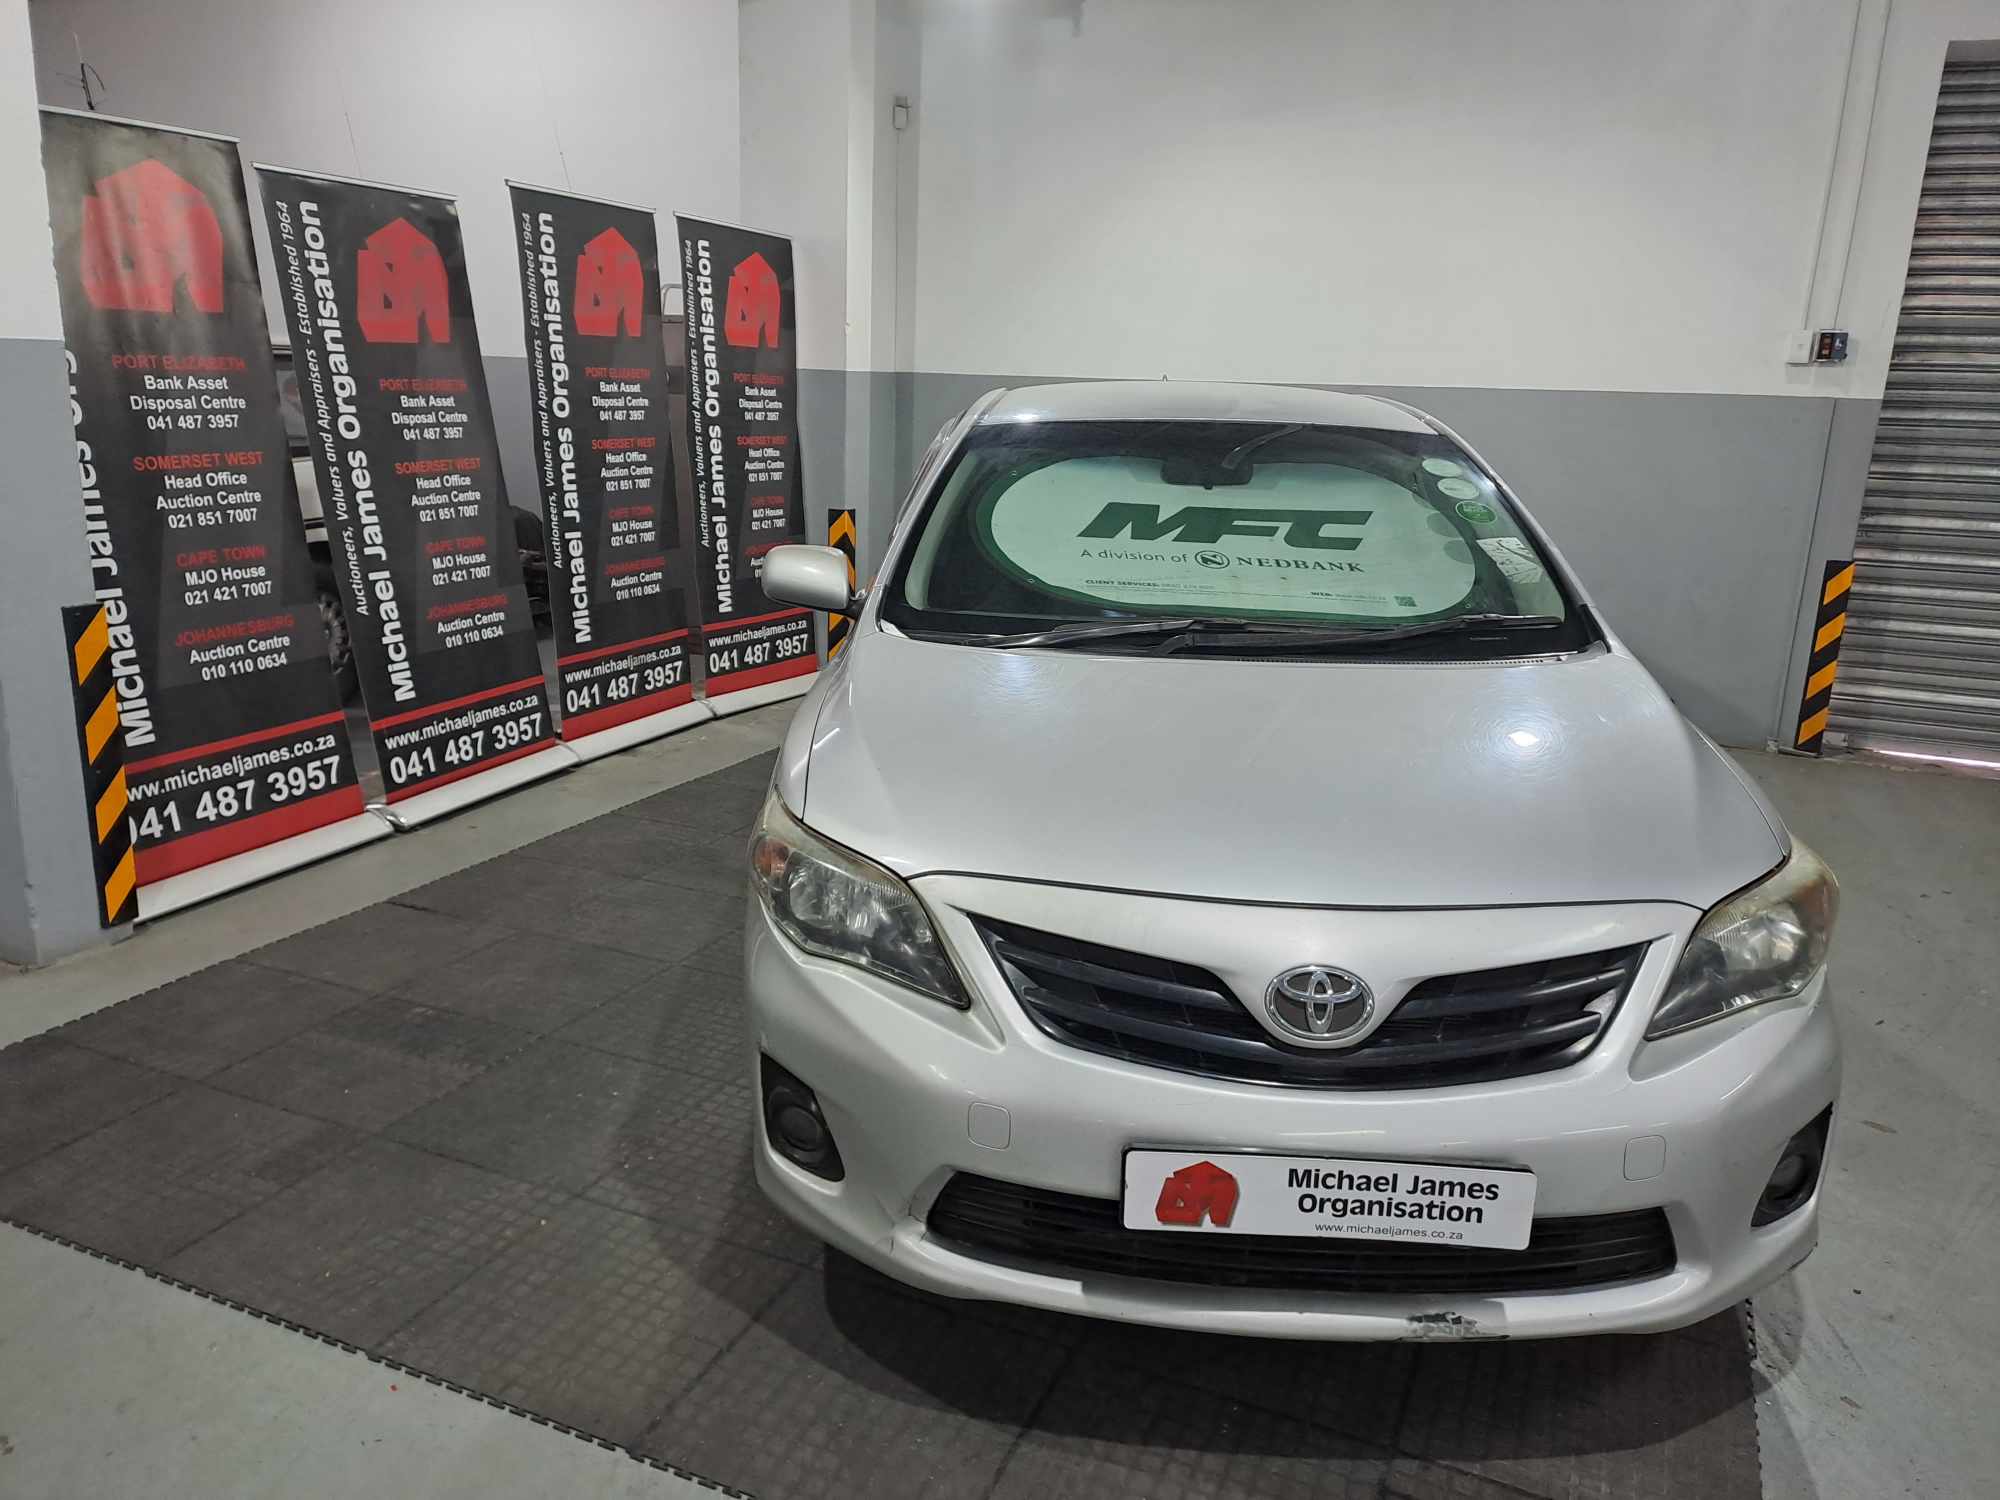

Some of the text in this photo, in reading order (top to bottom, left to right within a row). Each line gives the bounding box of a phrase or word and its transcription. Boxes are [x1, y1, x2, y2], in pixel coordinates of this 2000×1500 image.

[112, 354, 157, 369] PORT
[534, 339, 550, 407] Appraisers
[144, 375, 229, 390] Bank Asset
[130, 395, 246, 412] Disposal Centre
[275, 200, 369, 616] Auctioneers, Valuers and Appraisers Established 1964
[400, 395, 455, 407] Bank Asset
[592, 396, 624, 408] Disposal
[147, 414, 239, 430] 041 487 3957
[391, 411, 468, 426] Disposal Centre
[538, 411, 551, 438] and
[538, 212, 592, 644] Michael James Organisation
[696, 239, 732, 613] Michael James Organisation
[402, 427, 463, 440] 041 487 3957
[133, 451, 264, 471] SOMERSET WEST
[300, 200, 416, 702] Michael James Organisation
[606, 452, 647, 463] Head Office
[544, 440, 554, 487] Valuers
[601, 467, 629, 477] Auction
[164, 471, 248, 490] Head Office
[416, 474, 472, 489] Head Office
[156, 490, 262, 510] Auction Centre
[411, 490, 481, 507] Auction Centre
[168, 507, 257, 528] 021 851 7007
[420, 509, 437, 522] 021
[438, 507, 456, 520] 851
[630, 520, 652, 530] House
[1076, 501, 1374, 551] MFC
[176, 545, 266, 567] CAPE TOWN
[432, 553, 487, 570] MJO House
[1080, 549, 1365, 573] A division of NEDBANK
[185, 566, 266, 586] MJO House
[432, 565, 491, 586] 021 421 7007
[611, 575, 639, 587] Auction
[185, 581, 272, 605] 021 421 7007
[437, 611, 505, 634] Auction Centre
[708, 620, 807, 648] www.michaeljames.co.za
[445, 625, 504, 648] 010 110 0634
[190, 636, 291, 664] Auction Centre
[710, 633, 808, 673] 041 487 3957
[95, 588, 156, 748] Michael
[201, 651, 288, 681] 010 110 0634
[564, 645, 682, 684] www.michaeljames.co.za
[566, 660, 682, 712] 041 487 3957
[384, 694, 539, 751] www.michaeljames.co.za
[390, 712, 542, 784] 041 487 3957
[127, 734, 336, 802] ww.michaeljames.co.za
[195, 779, 255, 821] 487
[267, 755, 339, 802] 3957
[1287, 1167, 1500, 1201] Michael James
[1298, 1193, 1484, 1223] Organisation
[1314, 1223, 1464, 1241] www.michaeljames.co.za
